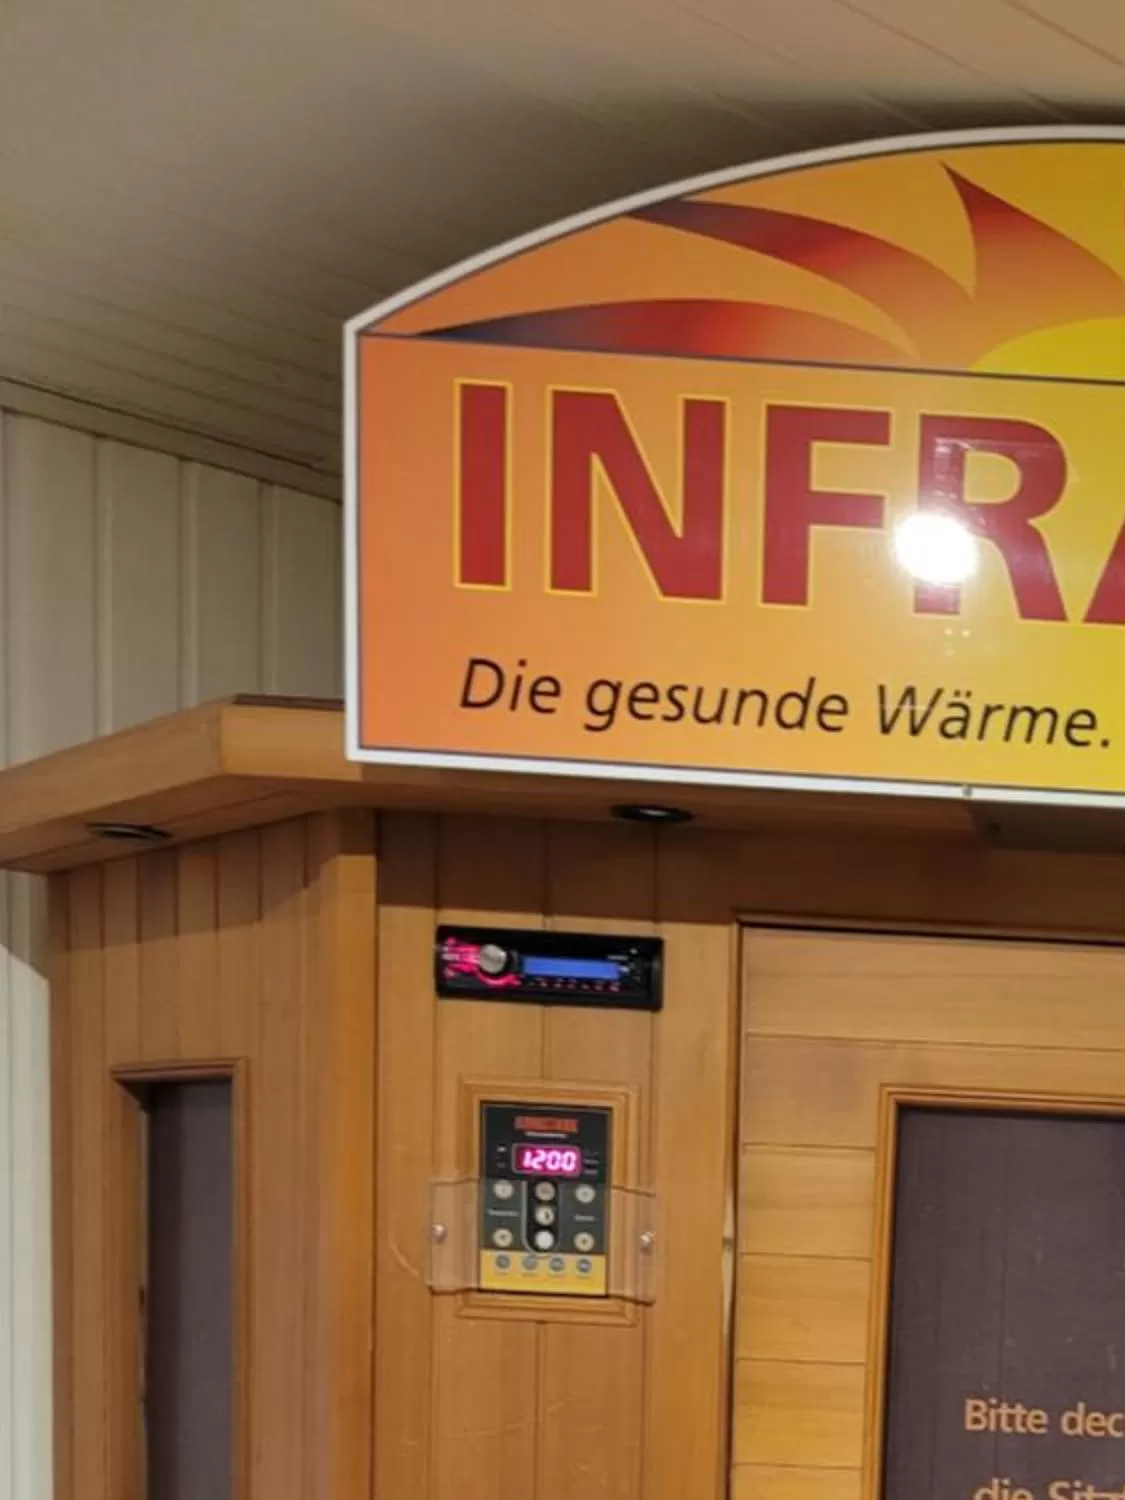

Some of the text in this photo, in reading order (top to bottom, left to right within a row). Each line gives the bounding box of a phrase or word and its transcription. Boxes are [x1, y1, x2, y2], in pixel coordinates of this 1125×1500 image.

[459, 659, 1112, 749] Die gesunde Wärme.
[964, 1399, 1047, 1433] Bitte
